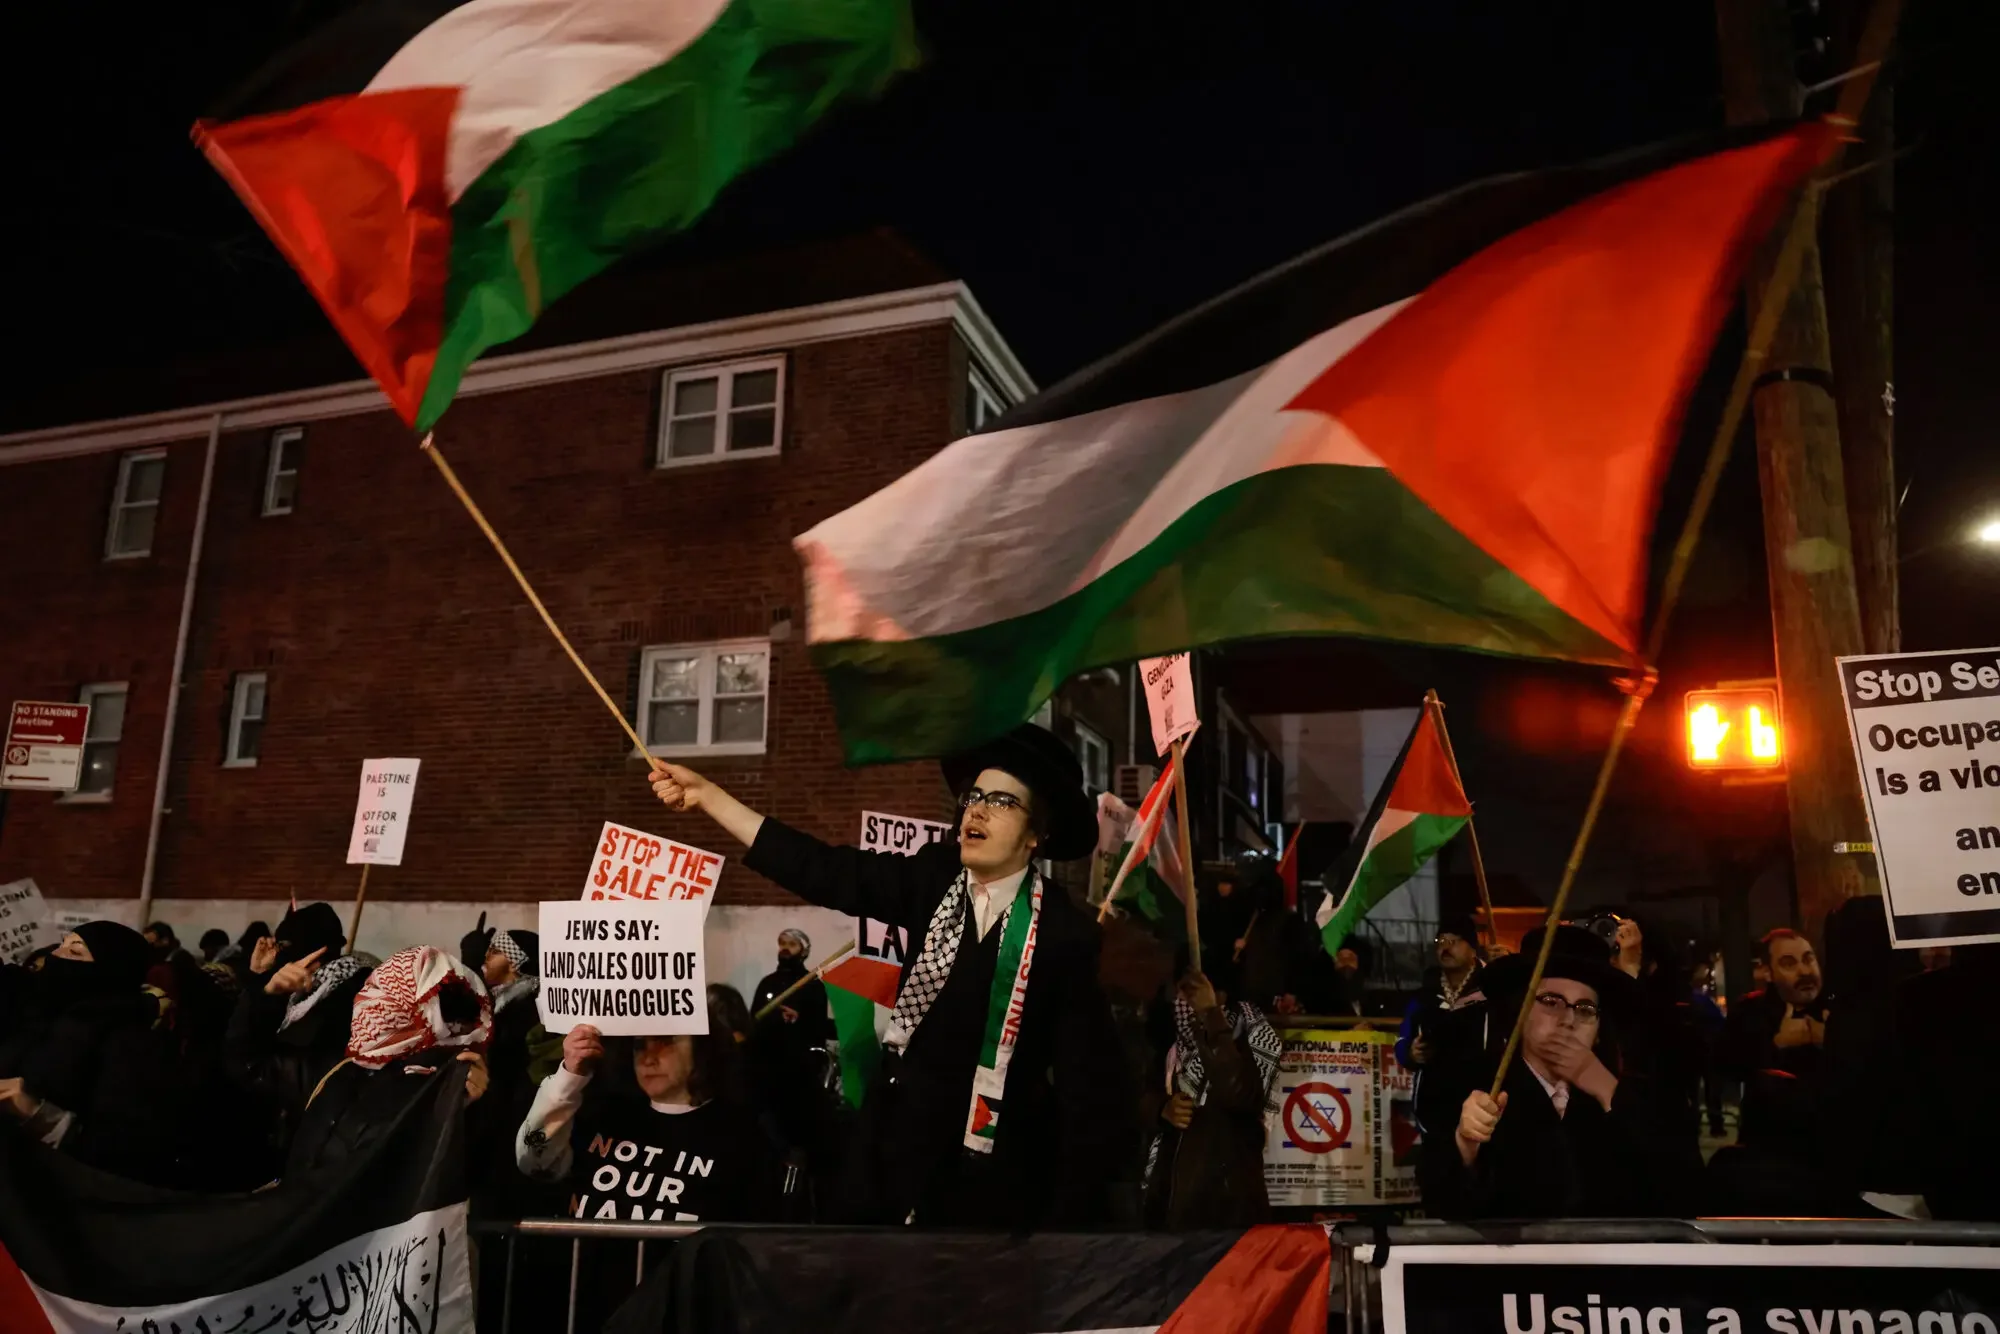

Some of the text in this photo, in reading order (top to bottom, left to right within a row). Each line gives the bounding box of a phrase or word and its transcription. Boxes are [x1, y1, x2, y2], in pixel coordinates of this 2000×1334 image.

[1855, 669, 1942, 701] Stop
[15, 716, 54, 727] Anytime
[16, 704, 79, 718] NO STANDING
[366, 772, 412, 785] PAESTINE
[377, 787, 386, 798] IS
[1919, 770, 1941, 793] a
[362, 811, 397, 822] OT FOR
[363, 825, 386, 836] SALE
[865, 816, 916, 850] STOP
[601, 827, 719, 887] STOP THE
[593, 859, 666, 900] SALE
[565, 920, 660, 941] JEWS SAY:
[544, 951, 696, 980] LAND SALES OUT OF
[547, 986, 695, 1017] OUR SYNAGOGUES
[587, 1131, 715, 1178] NOT IN
[592, 1164, 685, 1204] OUR
[1502, 1293, 1684, 1334] Using
[1706, 1307, 1742, 1334] a
